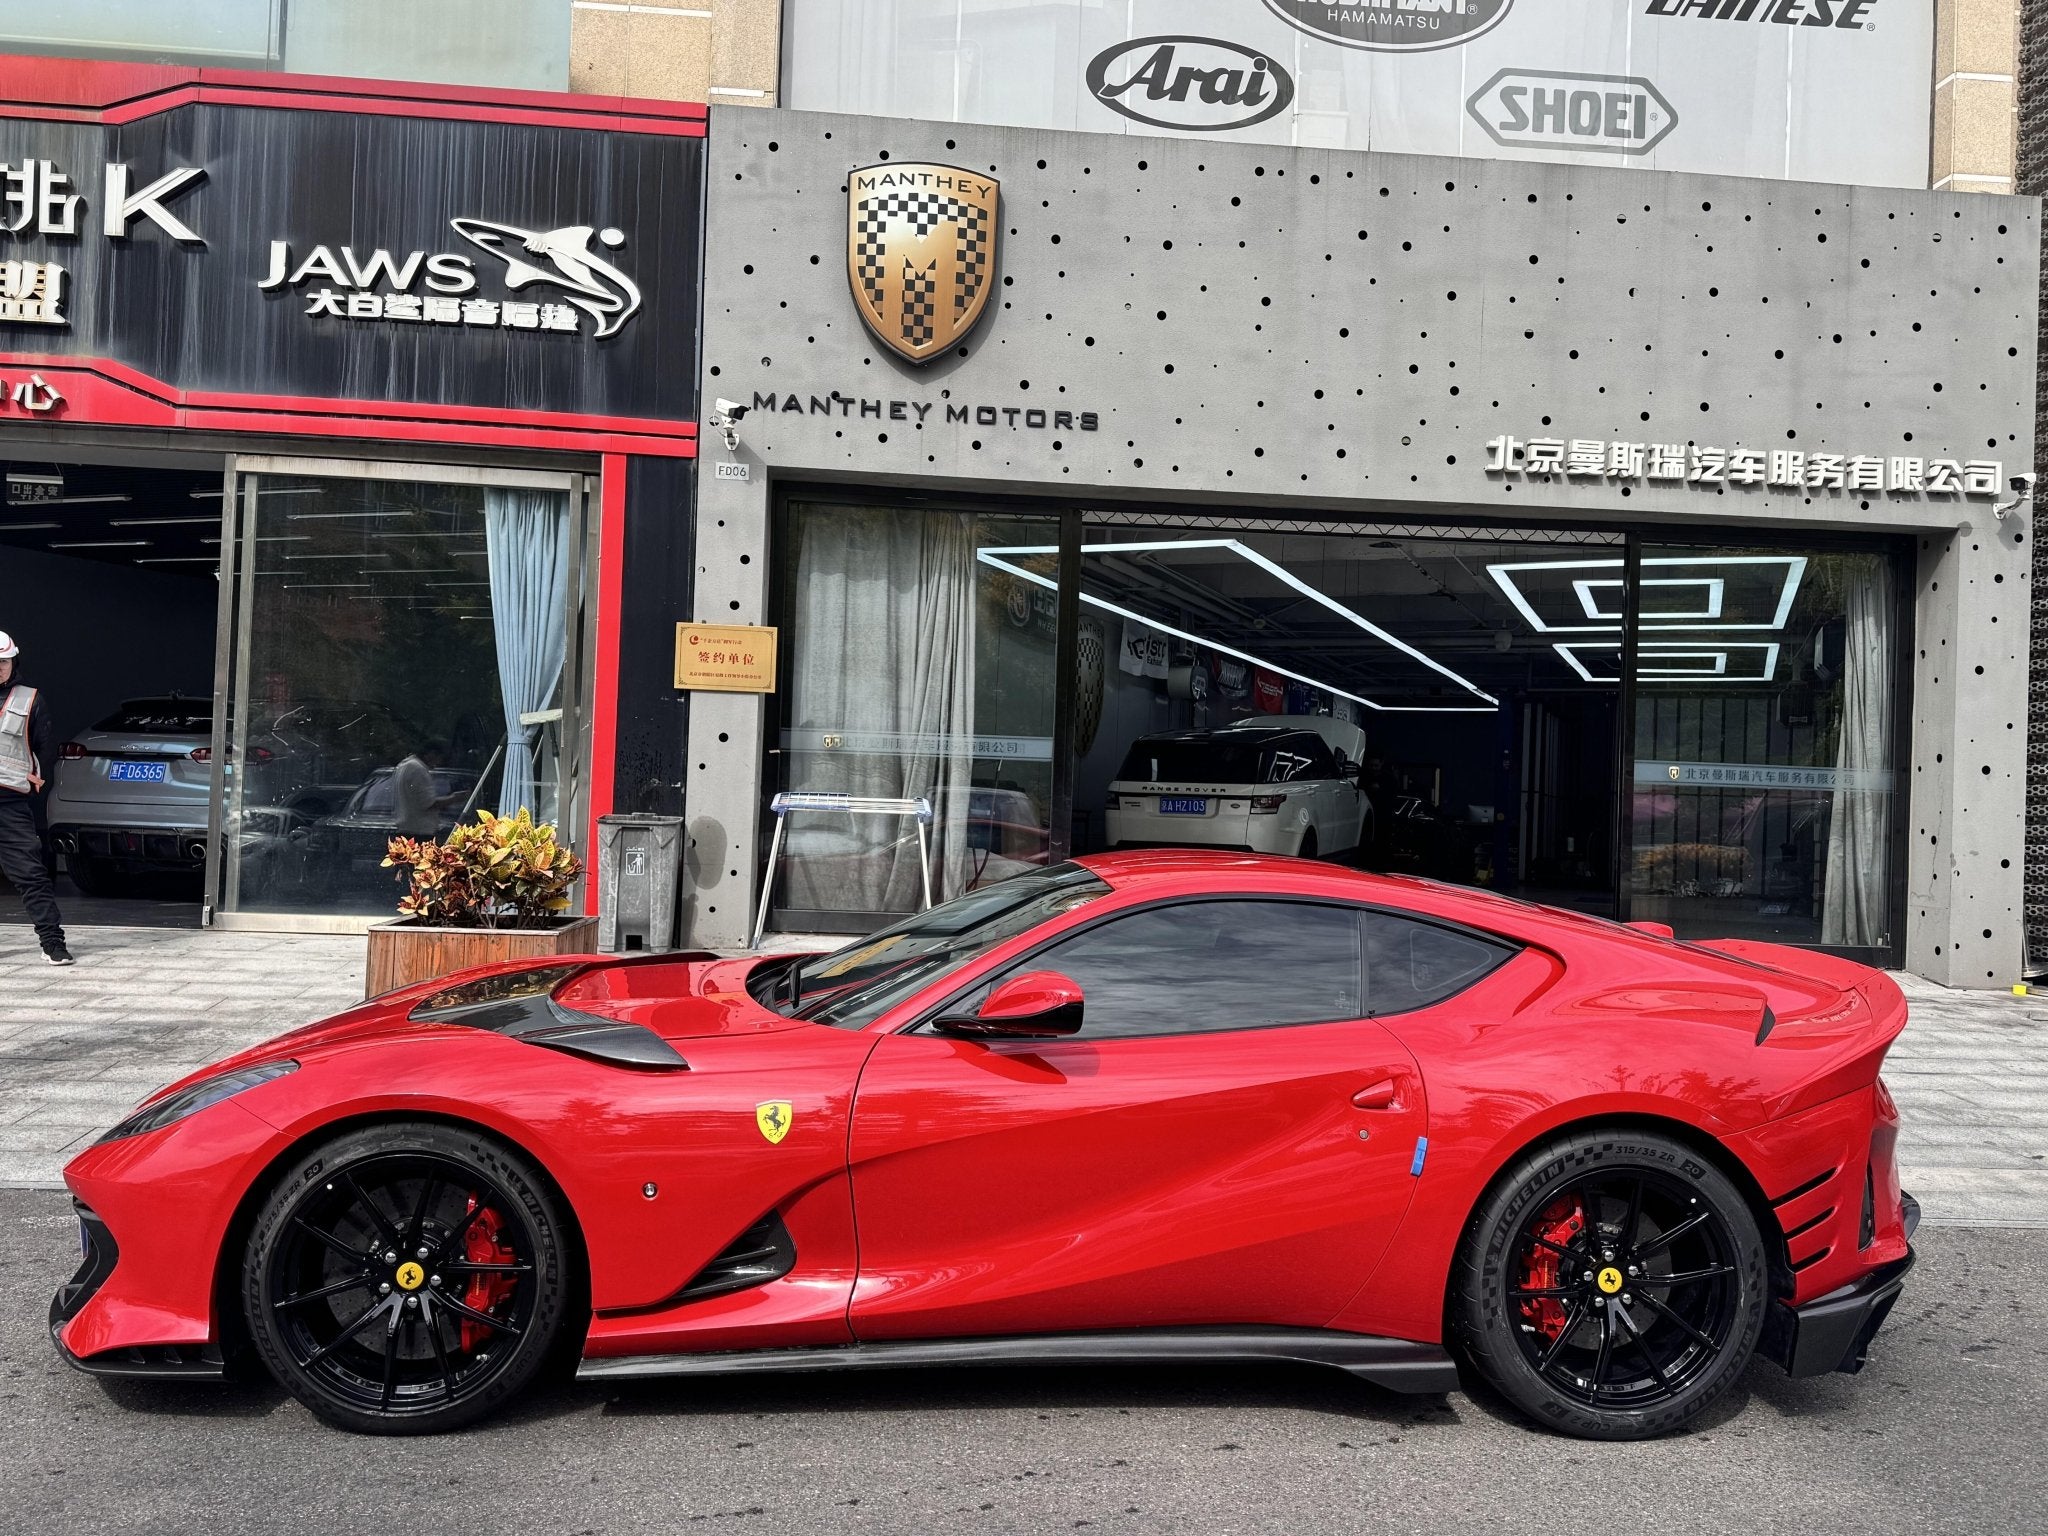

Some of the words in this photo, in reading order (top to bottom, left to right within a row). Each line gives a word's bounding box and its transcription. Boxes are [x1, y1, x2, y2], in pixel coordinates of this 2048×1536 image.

[1327, 9, 1441, 30] HAMAMATSU
[1097, 44, 1271, 103] Arai
[1499, 85, 1647, 140] SHOEI
[857, 172, 992, 199] MANTHEY
[257, 240, 478, 294] JAWS
[753, 390, 932, 421] MANTHEY
[946, 404, 1099, 431] MOTORS
[718, 465, 747, 477] FD06
[1486, 435, 2004, 498] 北京曼斯瑞汽车服务有限公司
[698, 651, 755, 666] 签约单位
[306, 1165, 319, 1178] 20
[1615, 1145, 1656, 1157] 315/35
[1659, 1151, 1675, 1163] ZR
[1685, 1163, 1700, 1175] 20
[1493, 1162, 1562, 1248] MICHELIN
[520, 1190, 558, 1286] MICHELIN
